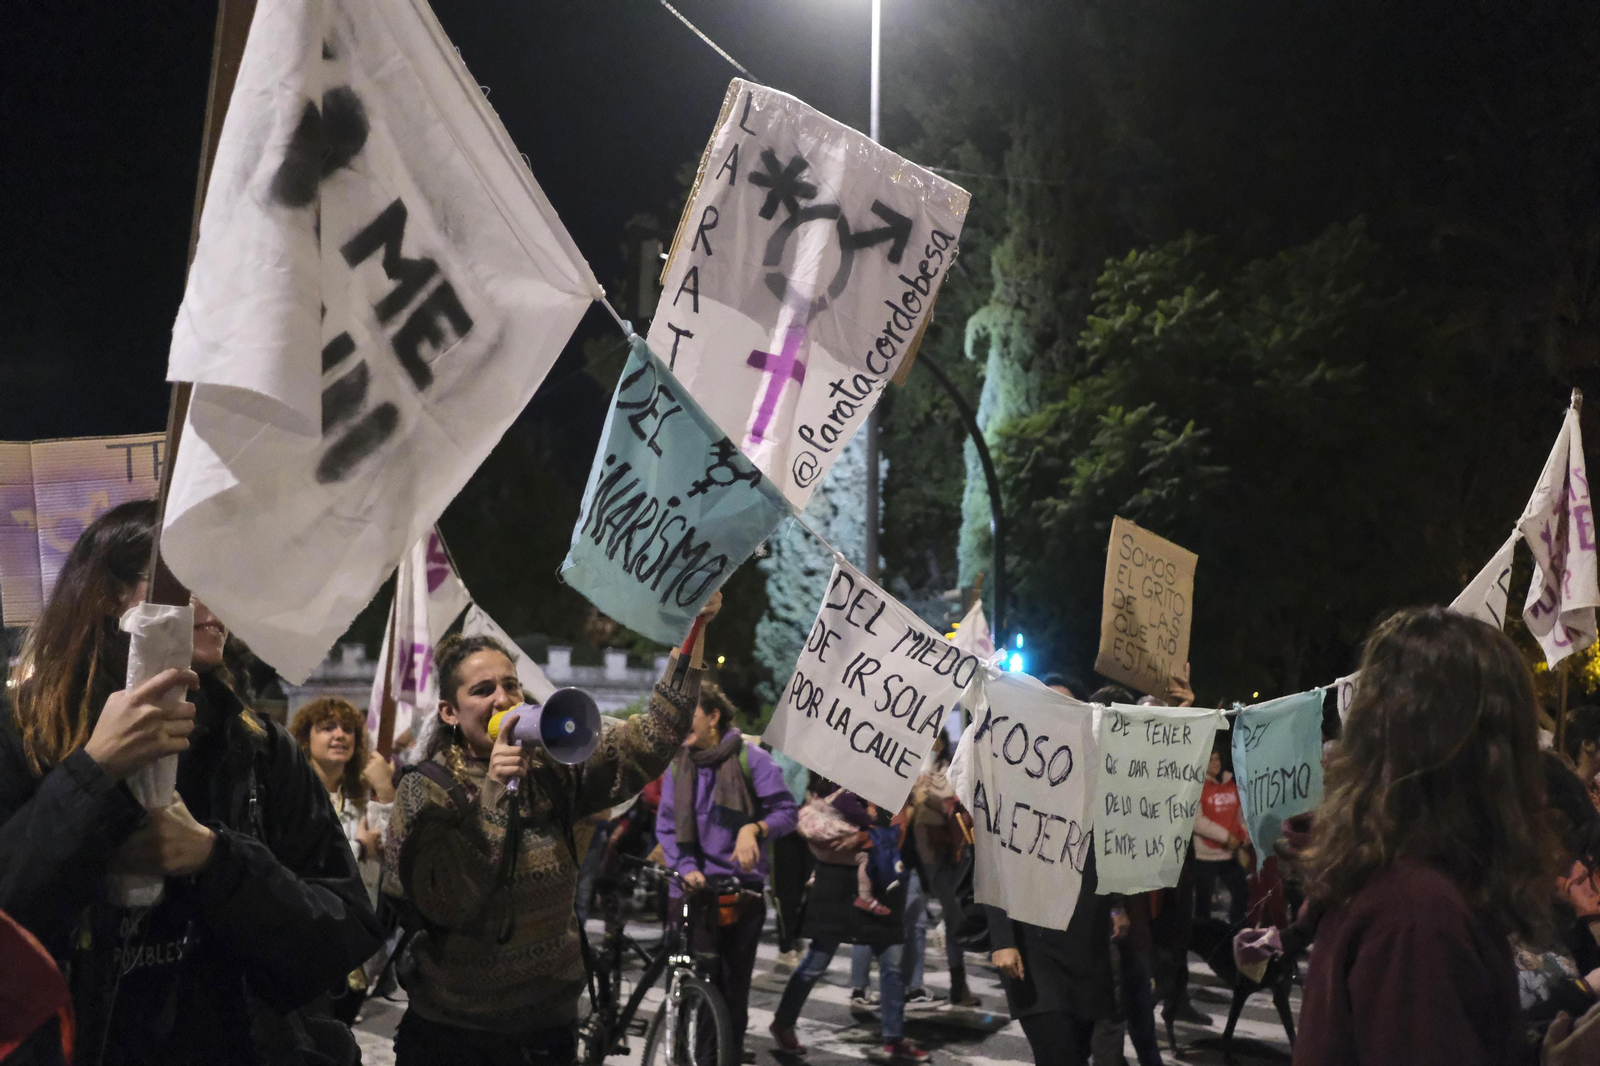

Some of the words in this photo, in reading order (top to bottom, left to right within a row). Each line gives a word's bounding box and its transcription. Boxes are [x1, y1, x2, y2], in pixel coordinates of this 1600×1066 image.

[792, 229, 956, 488] @laratacordobesa
[616, 360, 682, 458] DEL
[1119, 533, 1176, 586] SOMOS
[1111, 587, 1136, 615] DE
[1149, 606, 1181, 639] LAS
[1117, 564, 1134, 590] EL
[1142, 576, 1185, 617] GRITO
[825, 570, 886, 637] DEL
[890, 625, 980, 689] MIEDO
[1114, 614, 1148, 643] QUE
[1157, 636, 1177, 656] NO
[789, 671, 824, 718] POR
[826, 698, 852, 735] LA
[807, 619, 842, 663] DE
[842, 651, 882, 697] IR
[874, 674, 945, 739] SOLA
[1144, 719, 1192, 746] TENER
[1128, 759, 1149, 779] DAR
[1140, 797, 1161, 819] QUE
[1146, 835, 1165, 857] LAS
